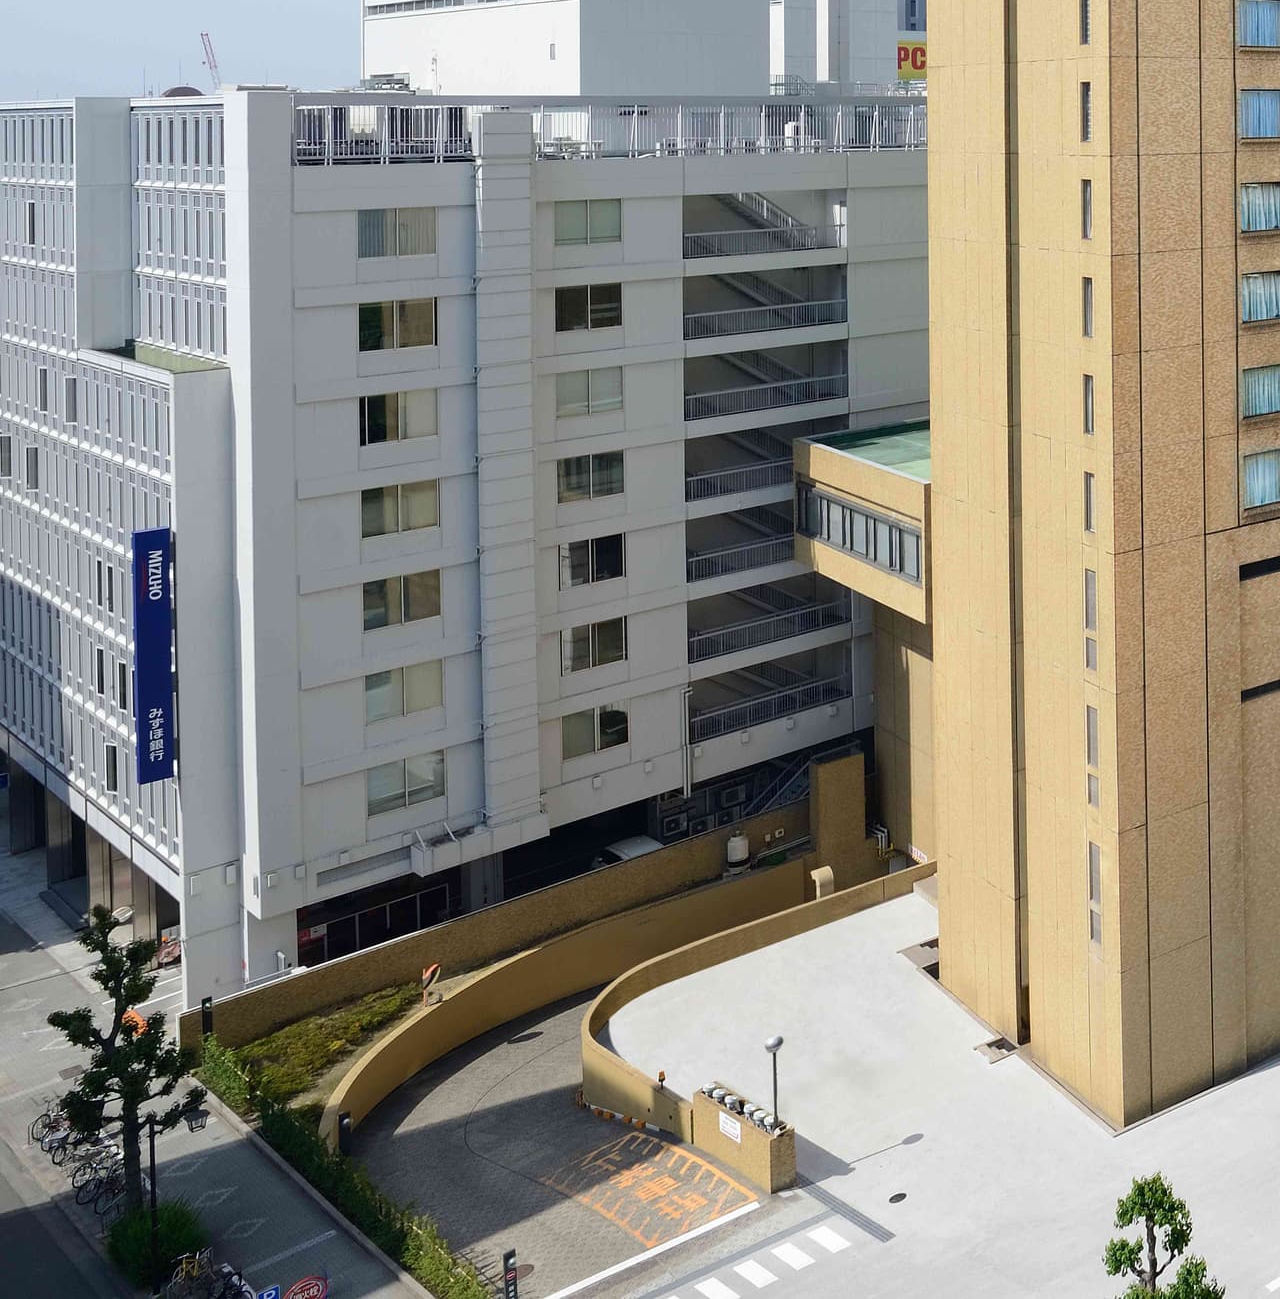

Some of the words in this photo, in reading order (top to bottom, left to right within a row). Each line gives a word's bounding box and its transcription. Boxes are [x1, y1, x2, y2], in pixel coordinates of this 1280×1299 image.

[147, 549, 163, 601] MIZUHO
[148, 707, 165, 762] みずほ銀行
